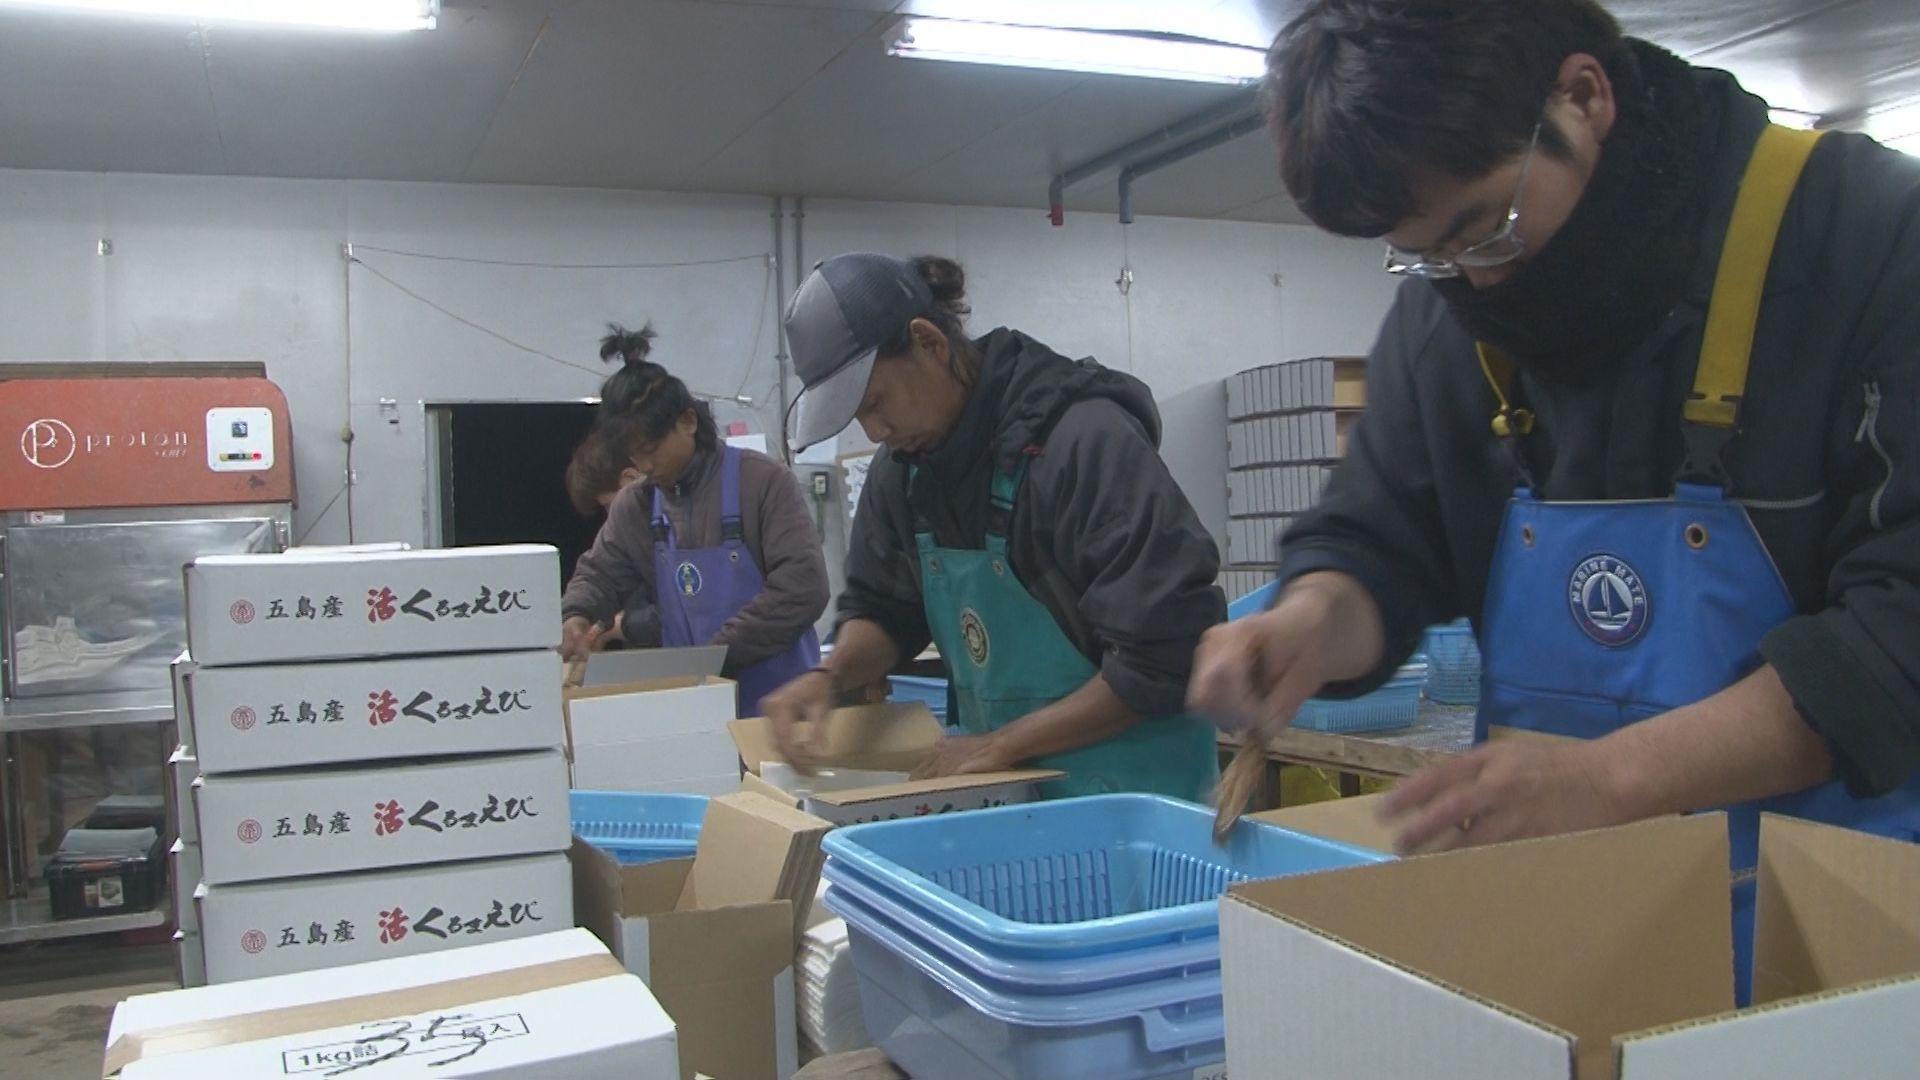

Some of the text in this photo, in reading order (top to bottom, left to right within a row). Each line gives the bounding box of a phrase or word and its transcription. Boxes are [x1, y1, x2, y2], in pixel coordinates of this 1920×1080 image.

[265, 586, 531, 623] 五島産 活くるまえび
[1572, 561, 1643, 605] MARINE MATE
[266, 686, 532, 726] 五島産 活くるまえび
[272, 794, 538, 838] 五島産 活くるまえび
[277, 901, 543, 947] 五島産 活くるまえび
